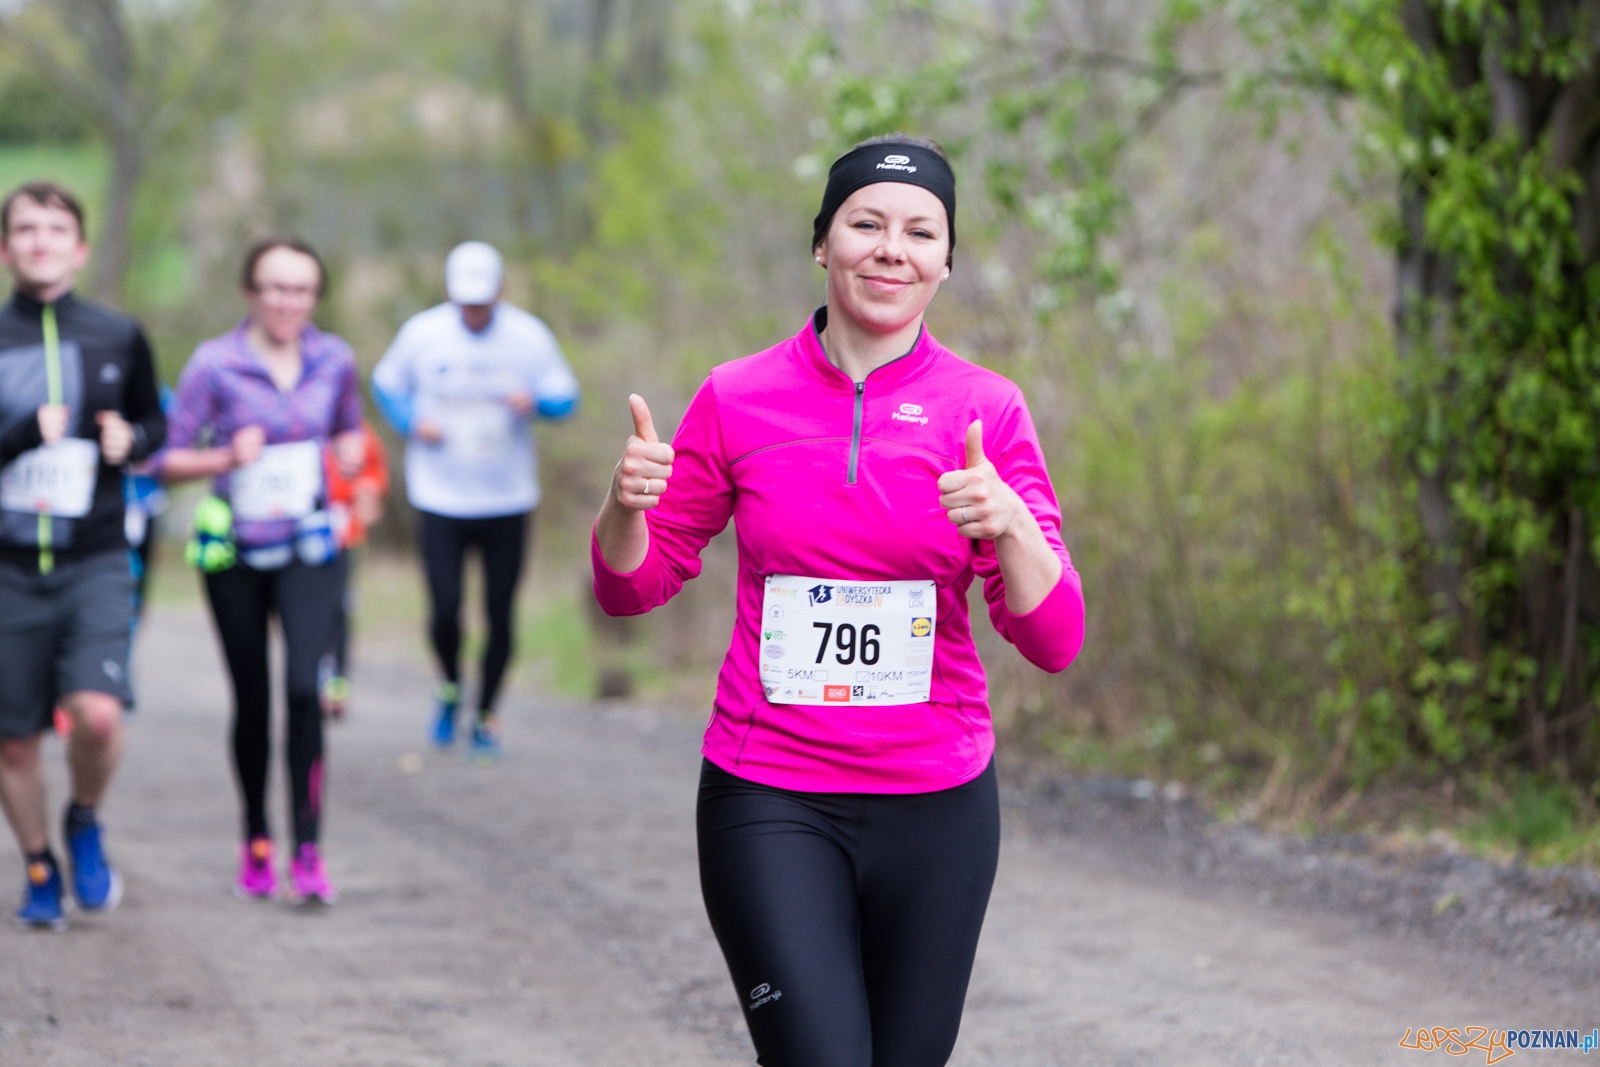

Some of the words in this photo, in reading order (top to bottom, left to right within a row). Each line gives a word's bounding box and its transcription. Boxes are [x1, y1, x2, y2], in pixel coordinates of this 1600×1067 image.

[836, 585, 892, 595] UNIWERSYTECKA
[812, 621, 881, 665] 796
[787, 668, 813, 681] 5KM
[870, 670, 904, 682] 10KM
